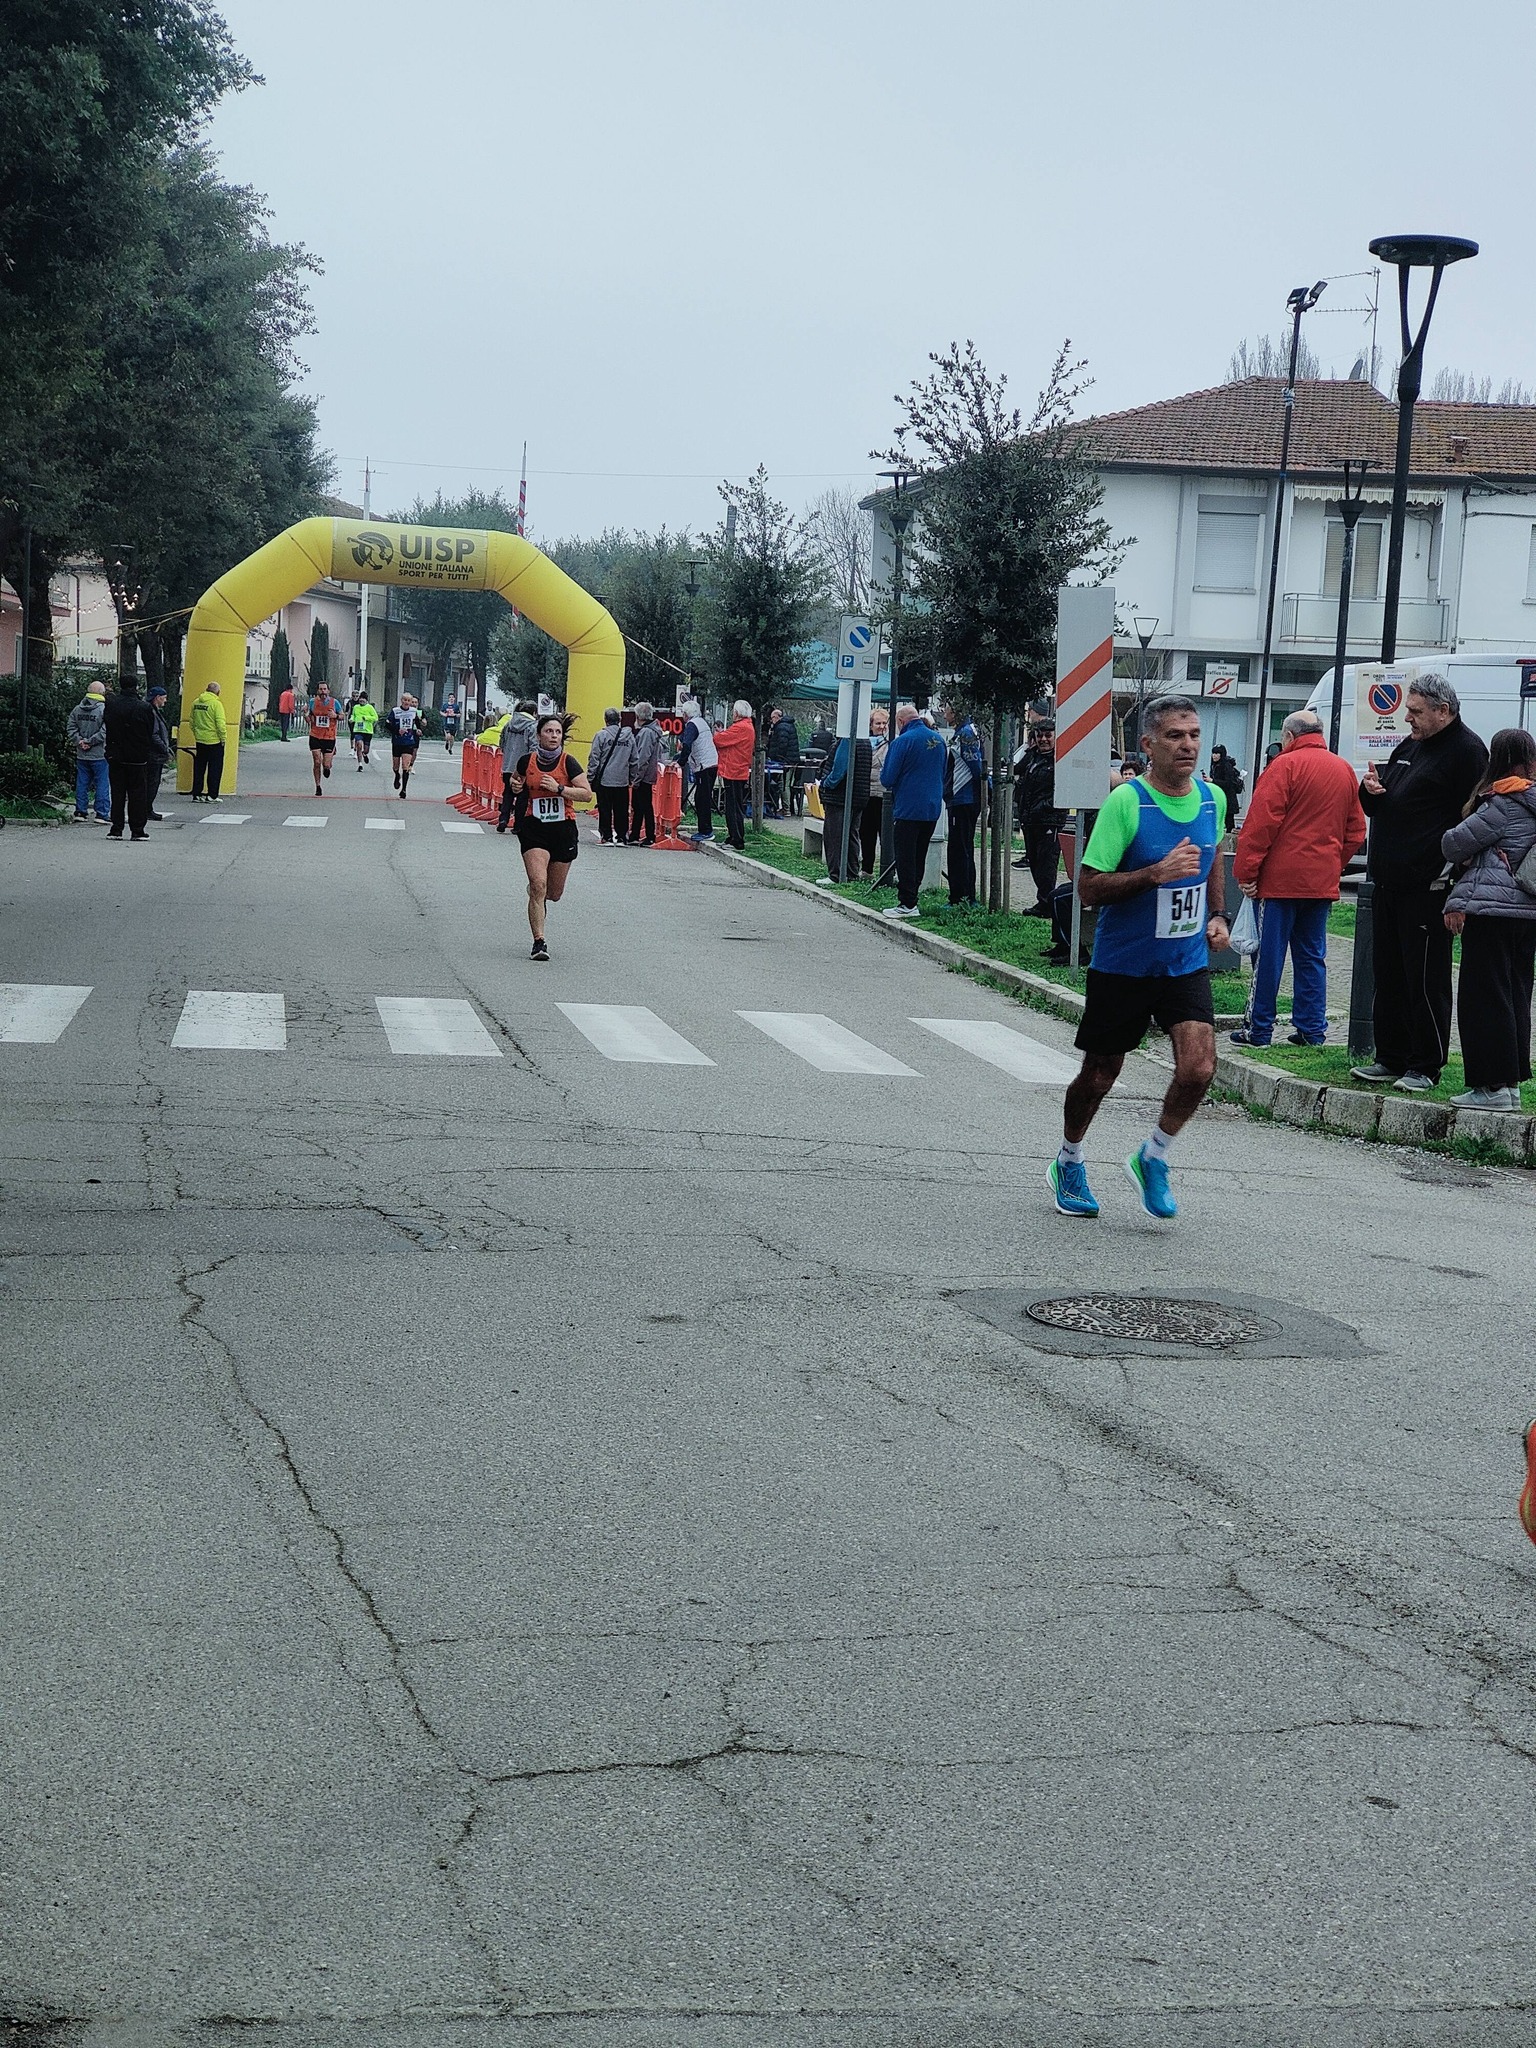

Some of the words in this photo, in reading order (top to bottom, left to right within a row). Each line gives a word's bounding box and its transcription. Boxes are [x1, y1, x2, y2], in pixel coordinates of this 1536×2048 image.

[400, 534, 475, 562] UISP
[399, 560, 433, 571] UNIONE
[436, 563, 474, 574] ITALIANA
[398, 569, 425, 578] SPORT
[447, 573, 469, 581] TUTTI
[844, 656, 852, 666] P
[539, 798, 559, 814] 678
[1172, 887, 1200, 920] 547
